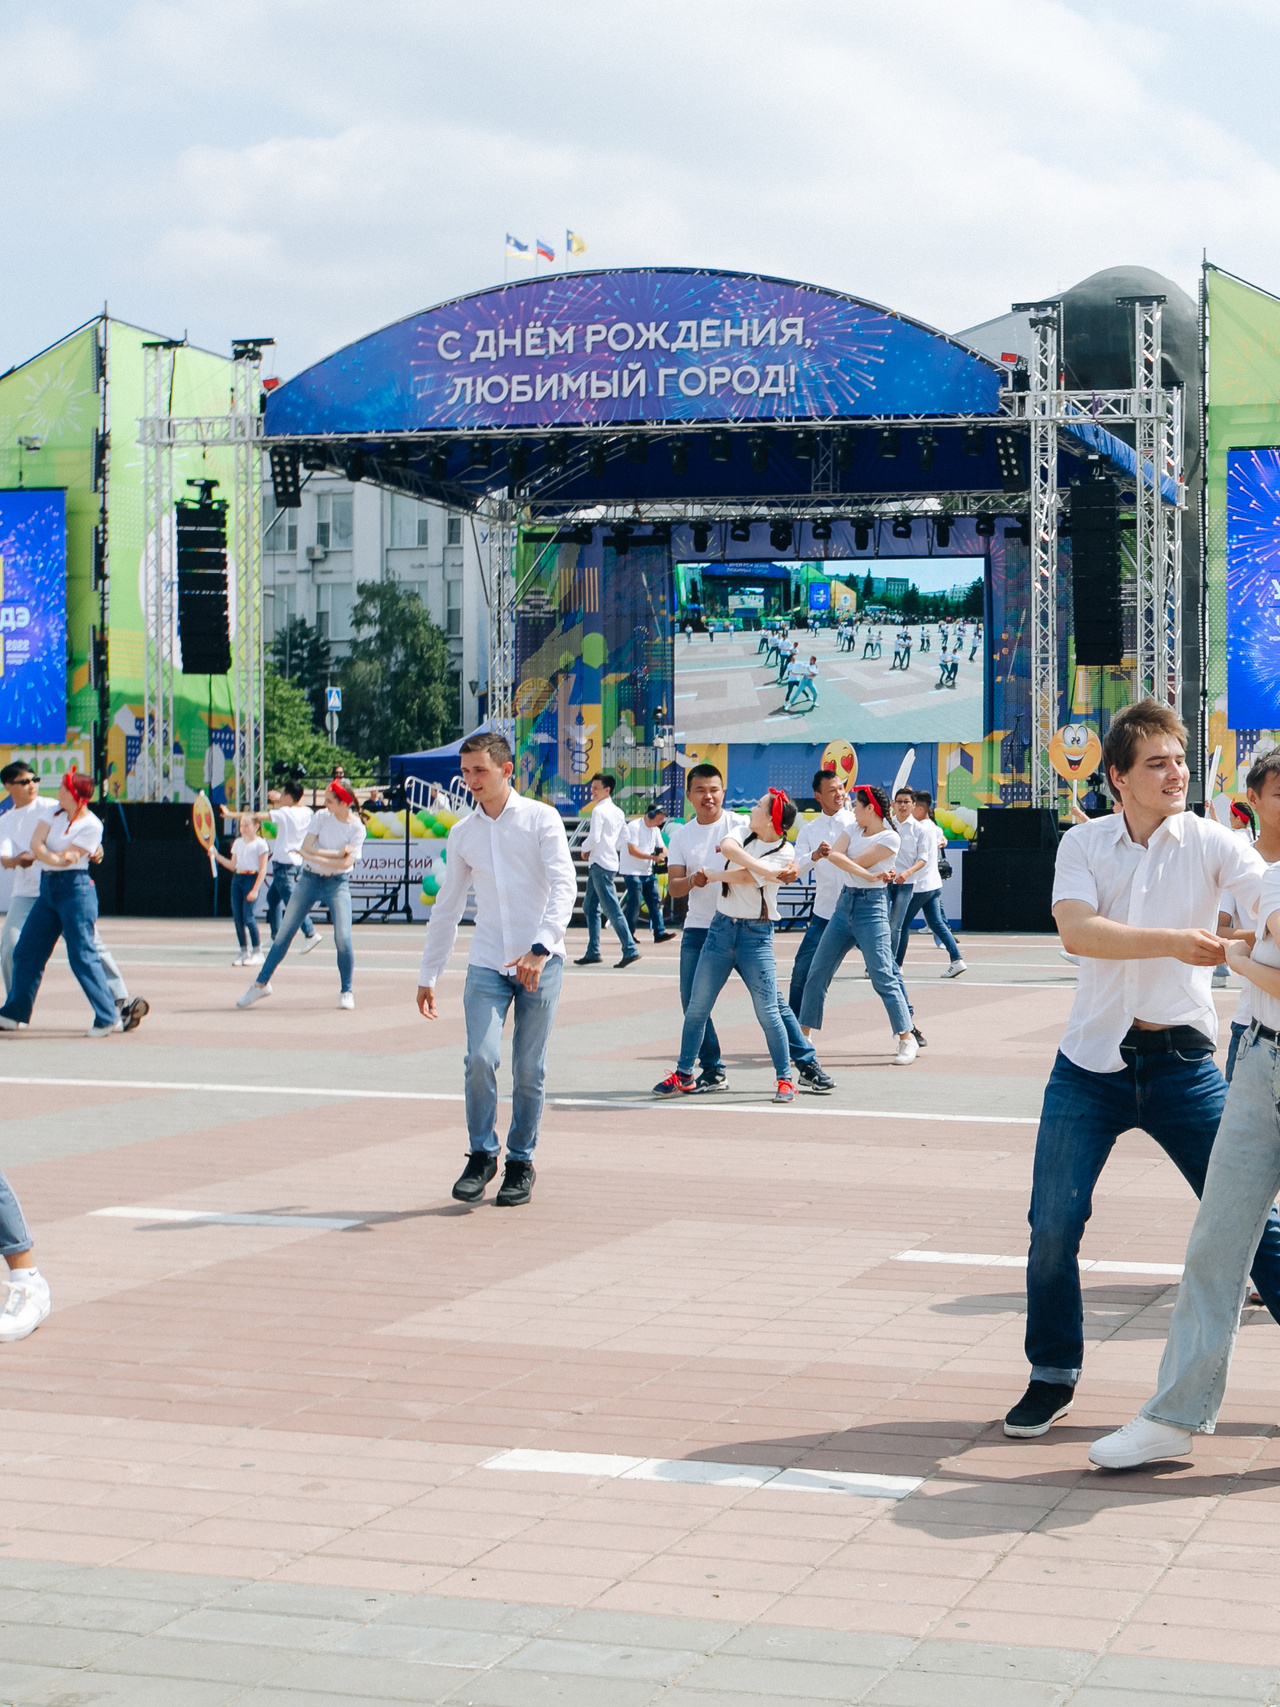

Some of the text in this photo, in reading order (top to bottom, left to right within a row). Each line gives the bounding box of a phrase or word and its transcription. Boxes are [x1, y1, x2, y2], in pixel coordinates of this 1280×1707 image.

[437, 317, 812, 363] С ДНЁМ РОЖДЕНИЯ,
[447, 363, 797, 405] ЛЮБИМЫЙ ГОРОД!
[5, 639, 31, 651] 2022
